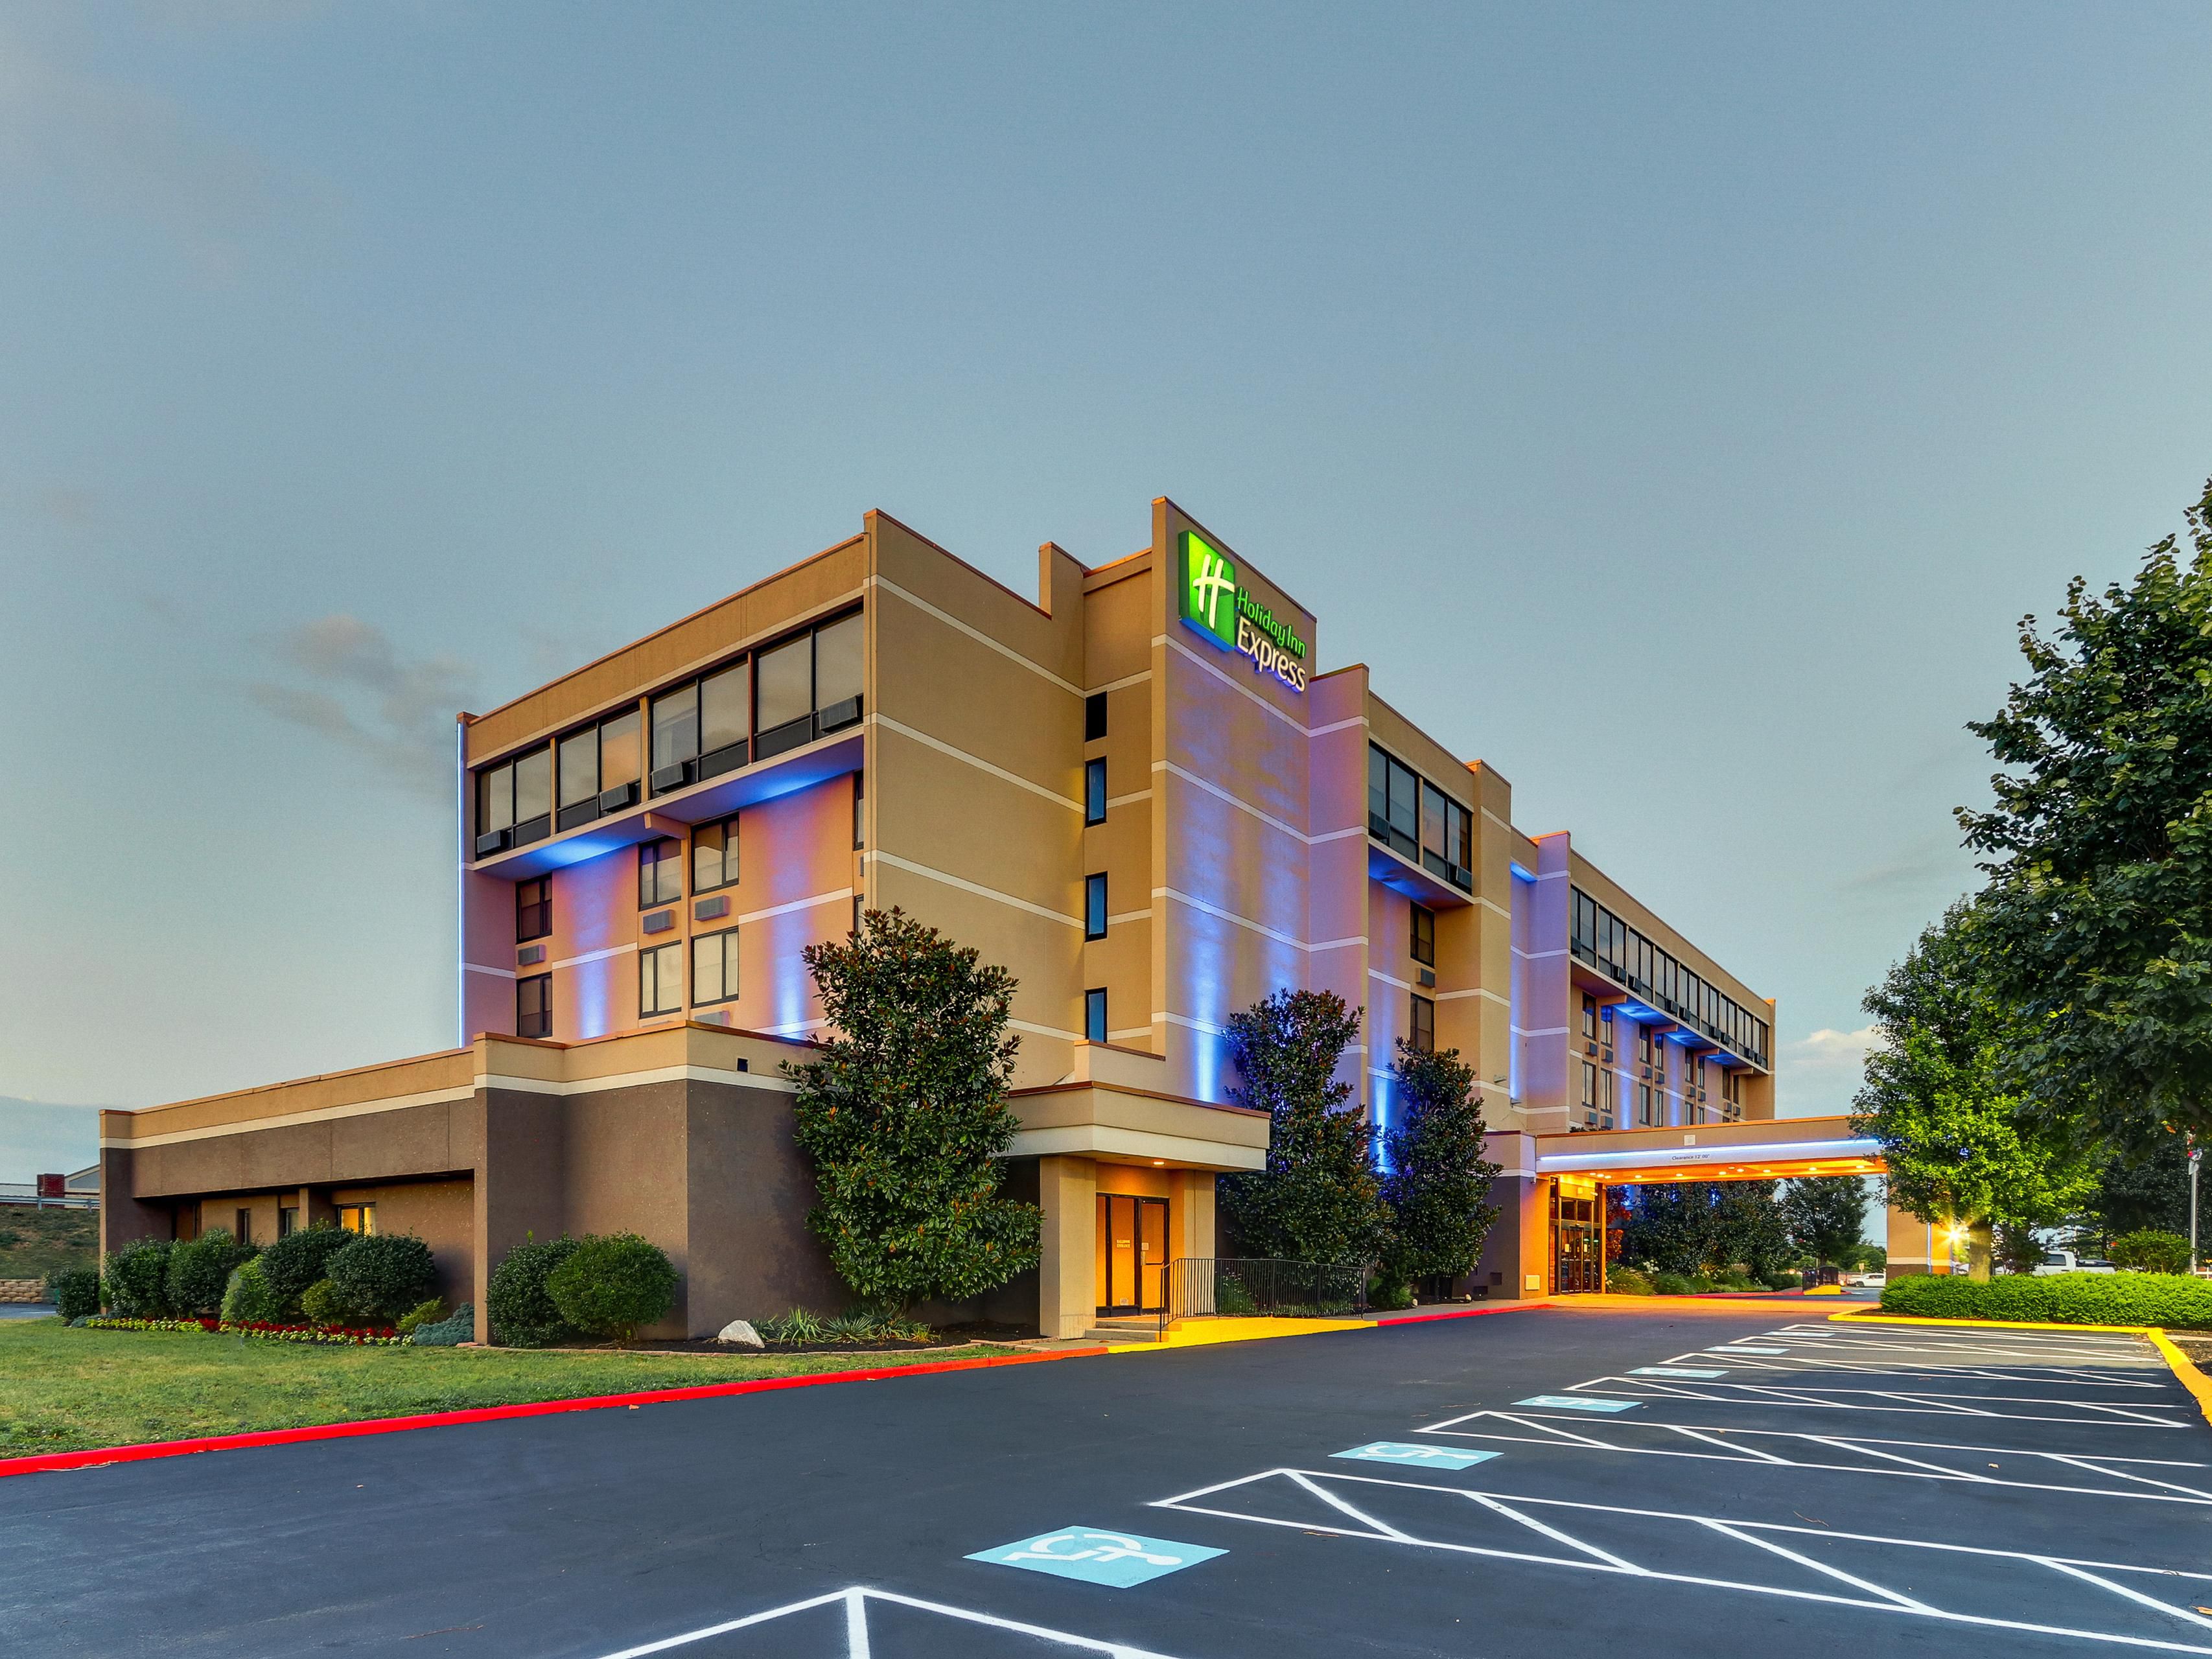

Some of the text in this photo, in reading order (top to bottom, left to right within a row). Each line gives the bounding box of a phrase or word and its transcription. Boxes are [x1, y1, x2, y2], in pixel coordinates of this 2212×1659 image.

[1237, 586, 1305, 658] Holiday Inn
[1237, 616, 1306, 692] Express
